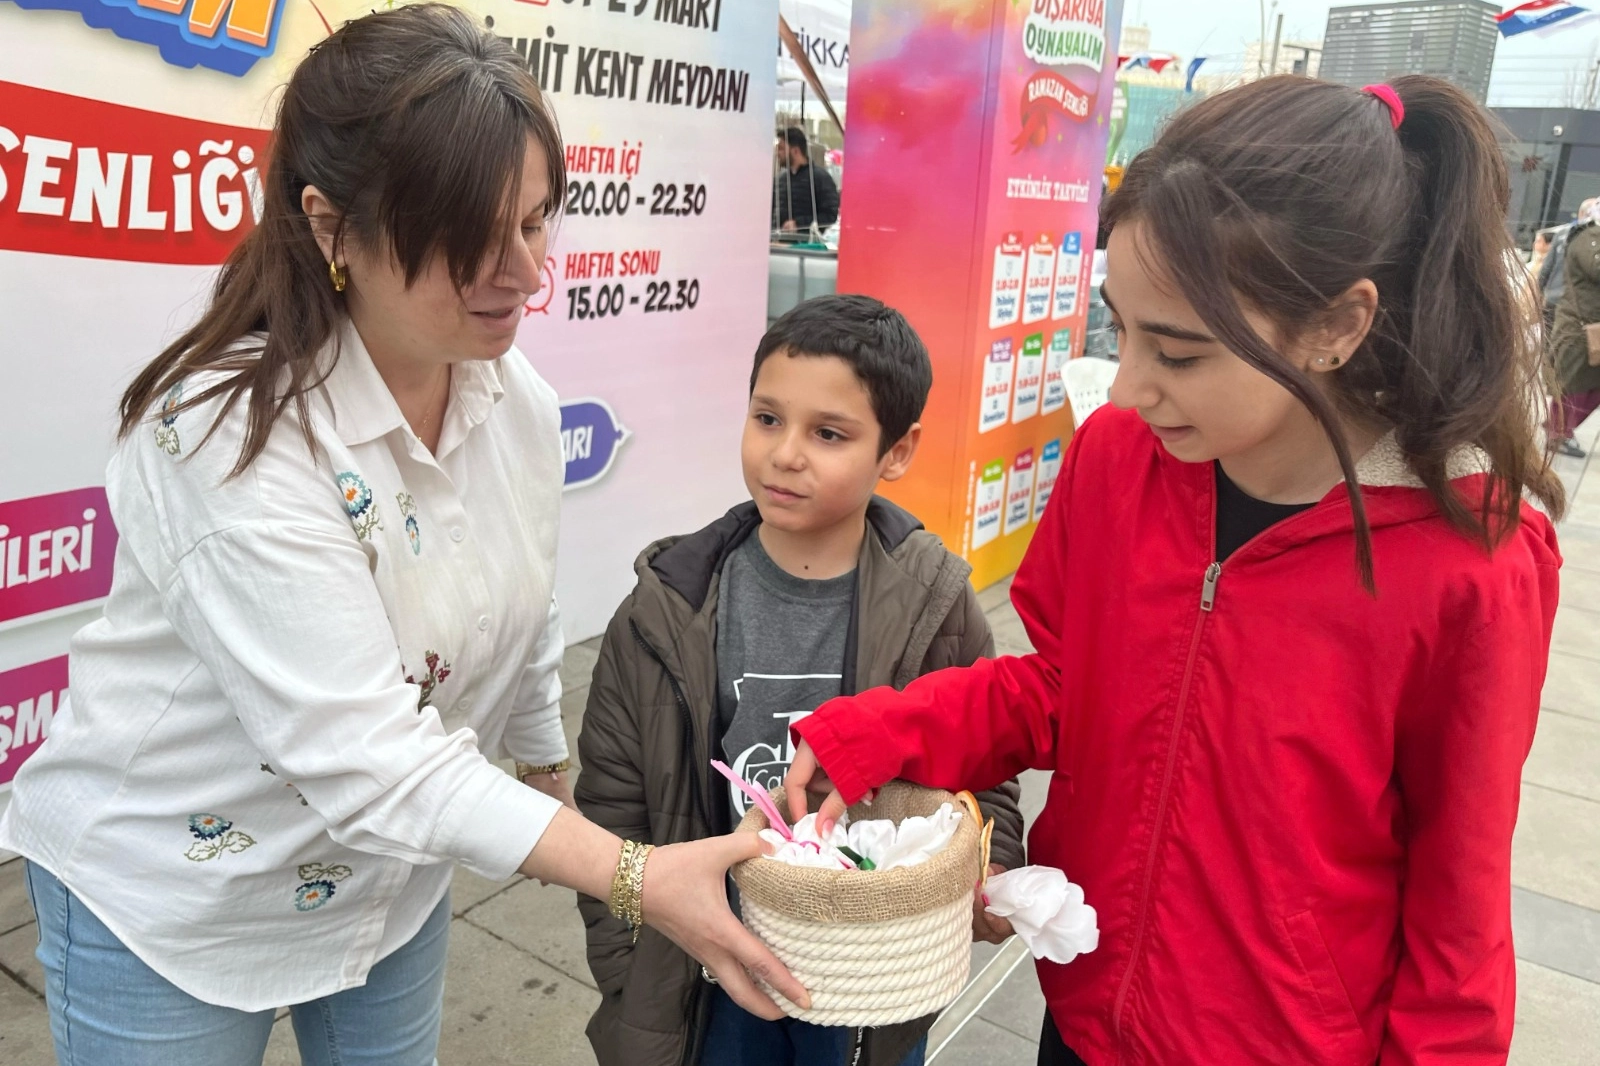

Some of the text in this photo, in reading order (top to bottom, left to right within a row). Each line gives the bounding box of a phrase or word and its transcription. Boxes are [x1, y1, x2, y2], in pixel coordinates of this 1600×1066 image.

[1026, 23, 1103, 65] OYNAYALIM
[574, 46, 644, 101] KENT
[647, 58, 750, 113] MEYDANI
[1028, 77, 1065, 103] RAMAZAN
[565, 140, 643, 181] HAFTA İÇİ
[565, 180, 631, 217] 20.00
[649, 182, 707, 217] 22.30
[565, 250, 661, 280] HAFTA SONU
[567, 283, 624, 321] 15.00
[644, 278, 700, 313] 22.30
